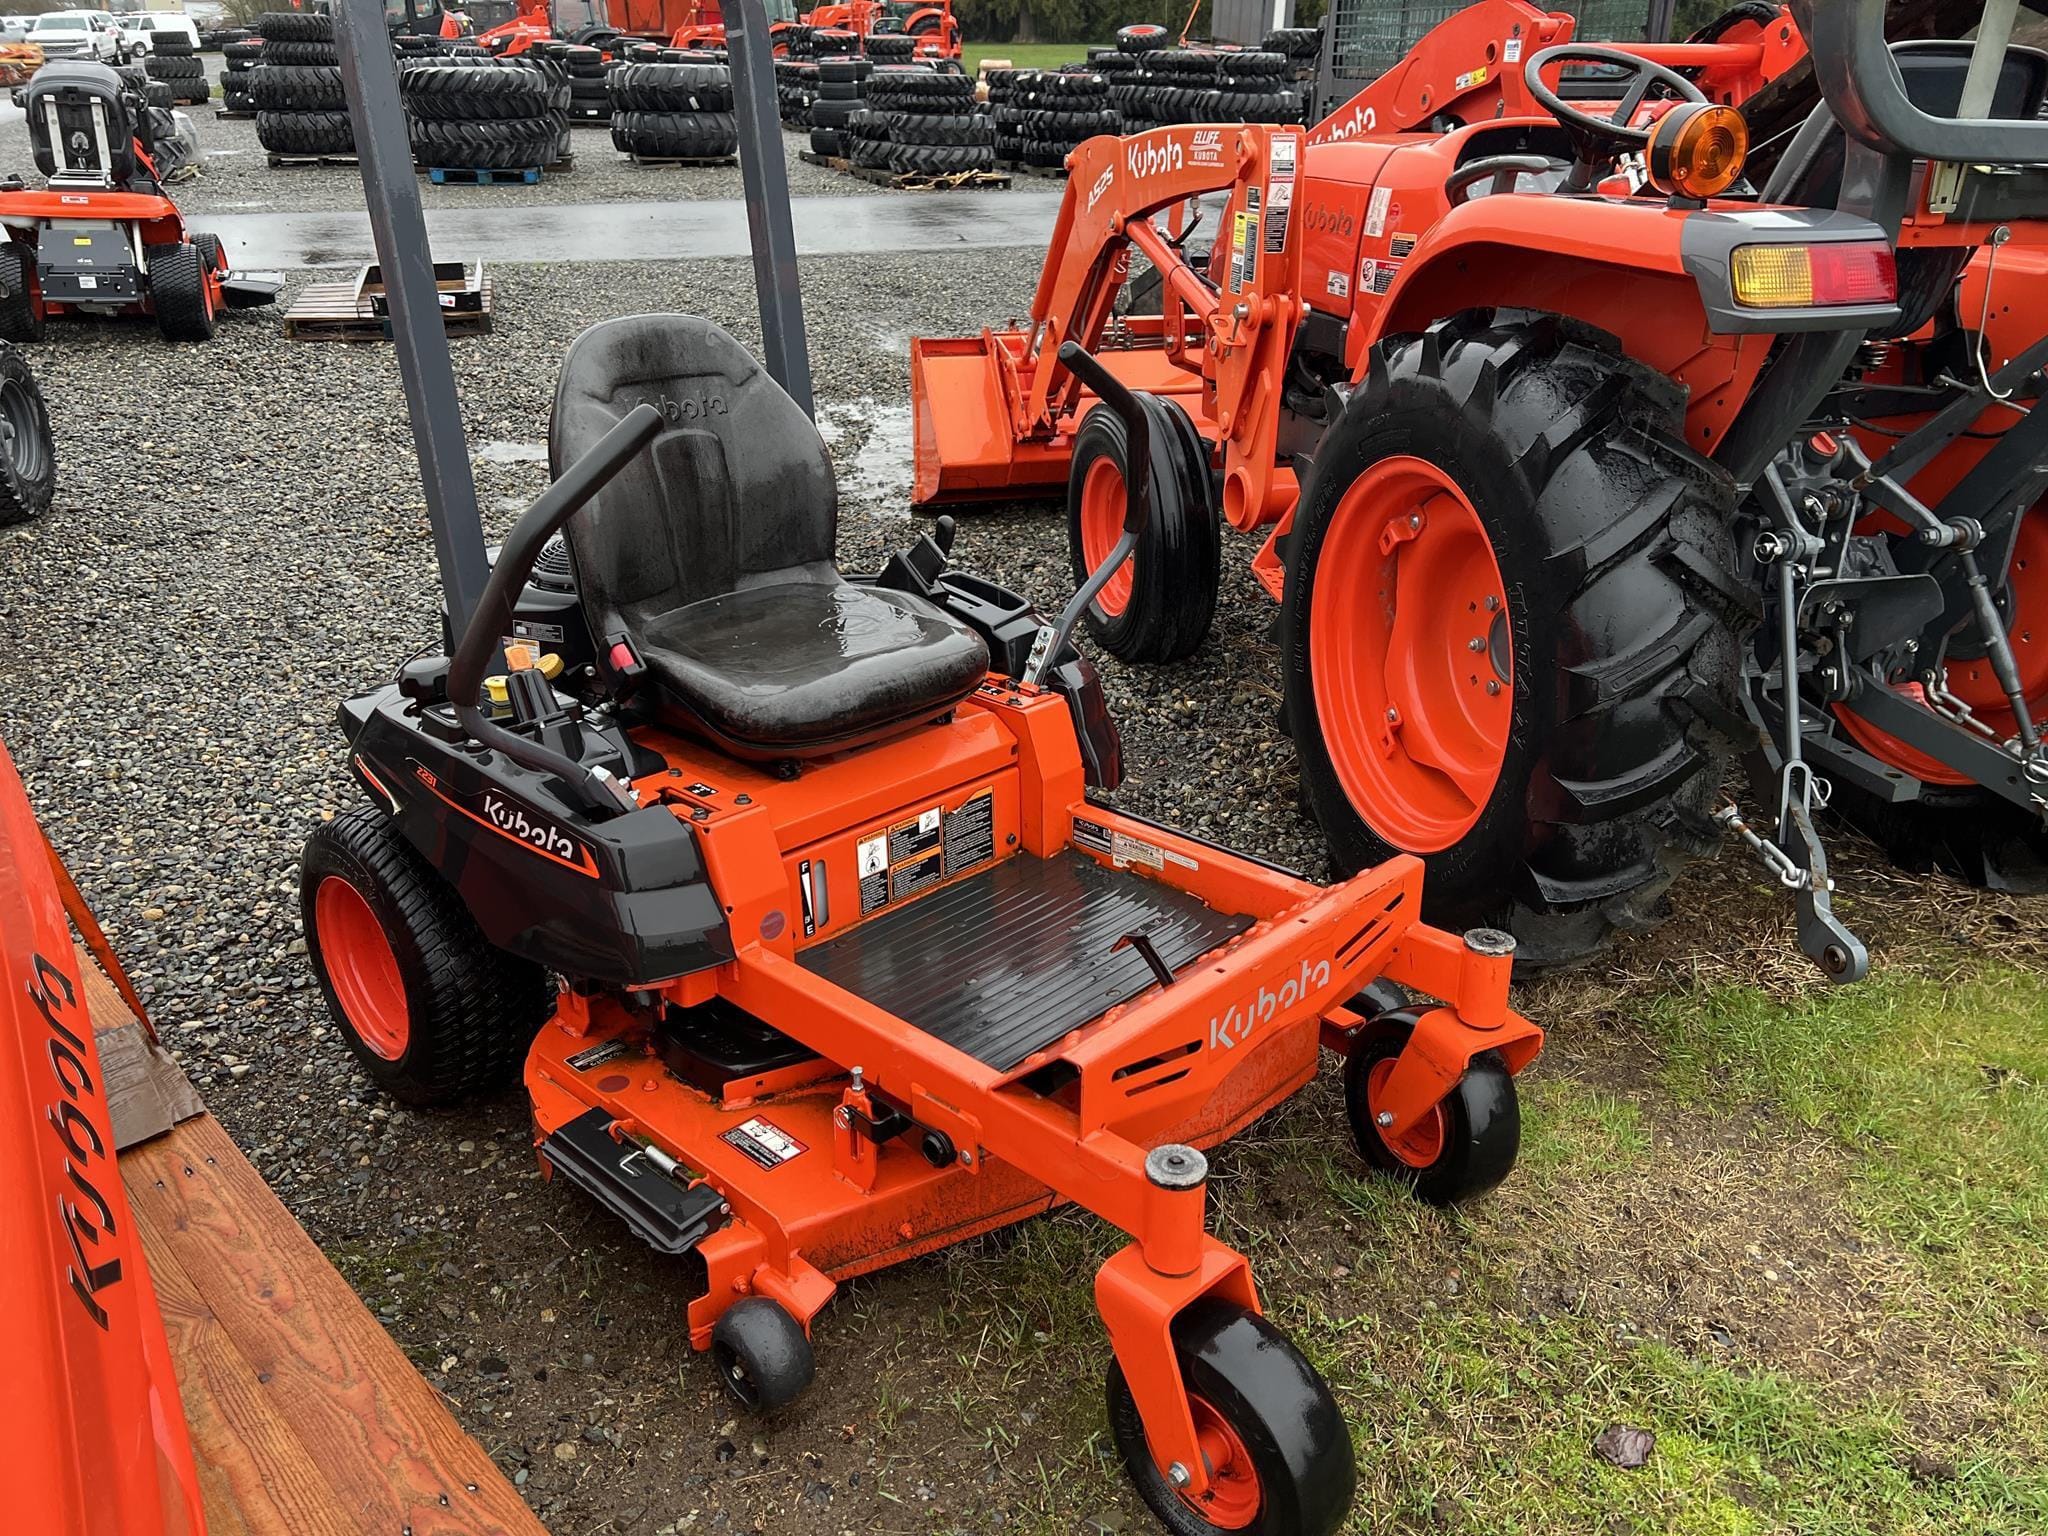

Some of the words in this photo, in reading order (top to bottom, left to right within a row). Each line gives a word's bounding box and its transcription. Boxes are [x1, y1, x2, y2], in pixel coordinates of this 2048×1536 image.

[1193, 131, 1220, 145] ELLIFF
[1128, 134, 1183, 179] Kubota
[1194, 151, 1217, 161] KUBOTA
[484, 795, 574, 859] Kubota
[801, 862, 809, 873] F
[806, 924, 814, 935] E
[1210, 959, 1330, 1050] Kubota
[25, 951, 123, 1331] Kubota
